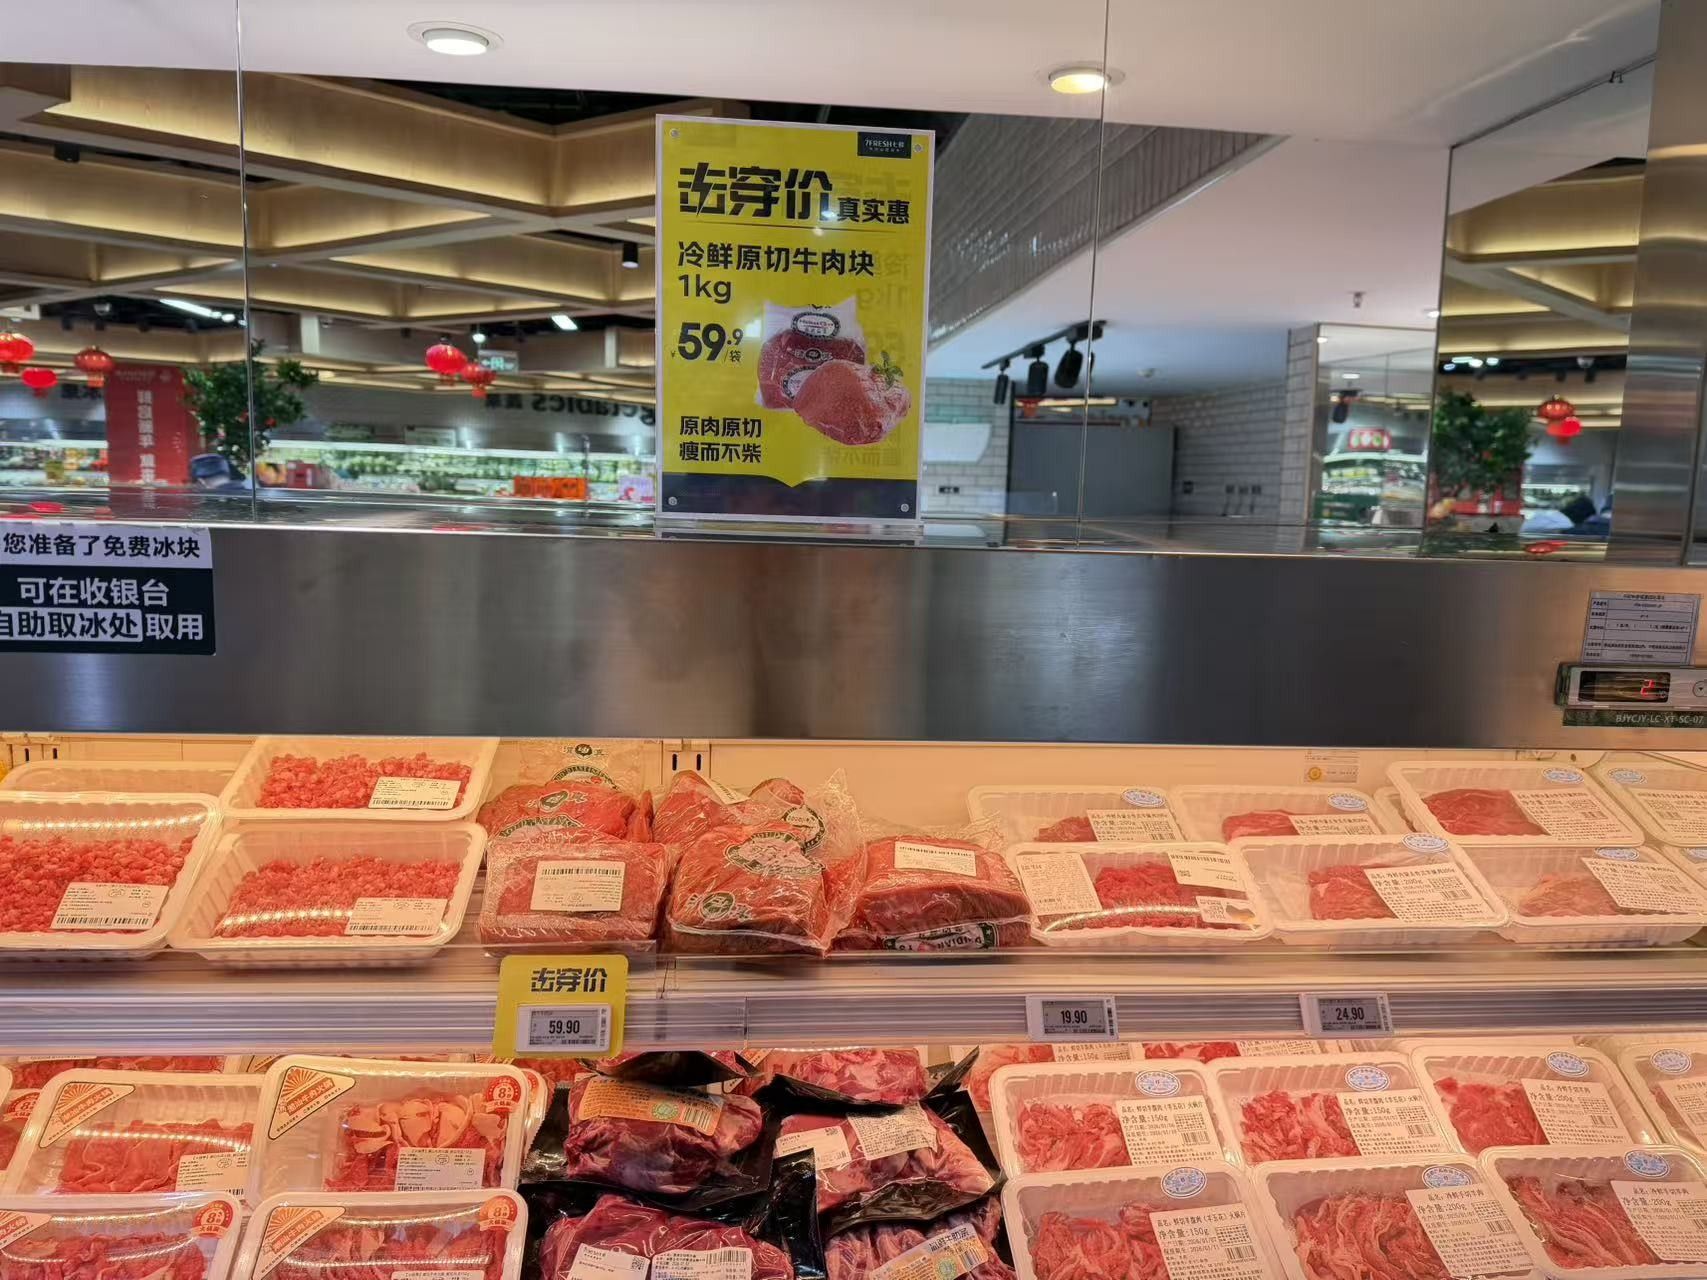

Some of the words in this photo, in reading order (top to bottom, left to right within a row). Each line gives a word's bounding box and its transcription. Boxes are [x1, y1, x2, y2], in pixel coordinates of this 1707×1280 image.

[677, 162, 833, 221] 击穿价
[837, 197, 911, 225] 真实惠
[677, 240, 875, 277] 冷鲜原切牛肉块
[678, 274, 732, 304] 1kg
[679, 415, 763, 438] 原肉原切
[679, 441, 763, 464] 瘦而不柴
[3, 532, 201, 559] 您准备了免费冰块
[17, 576, 170, 607] 可在收银台
[531, 967, 608, 992] 击穿价
[1060, 1009, 1088, 1025] 19.90
[1335, 1006, 1365, 1021] 24.90
[549, 1020, 580, 1034] 59.90
[1158, 1227, 1210, 1240] 净含量:150g
